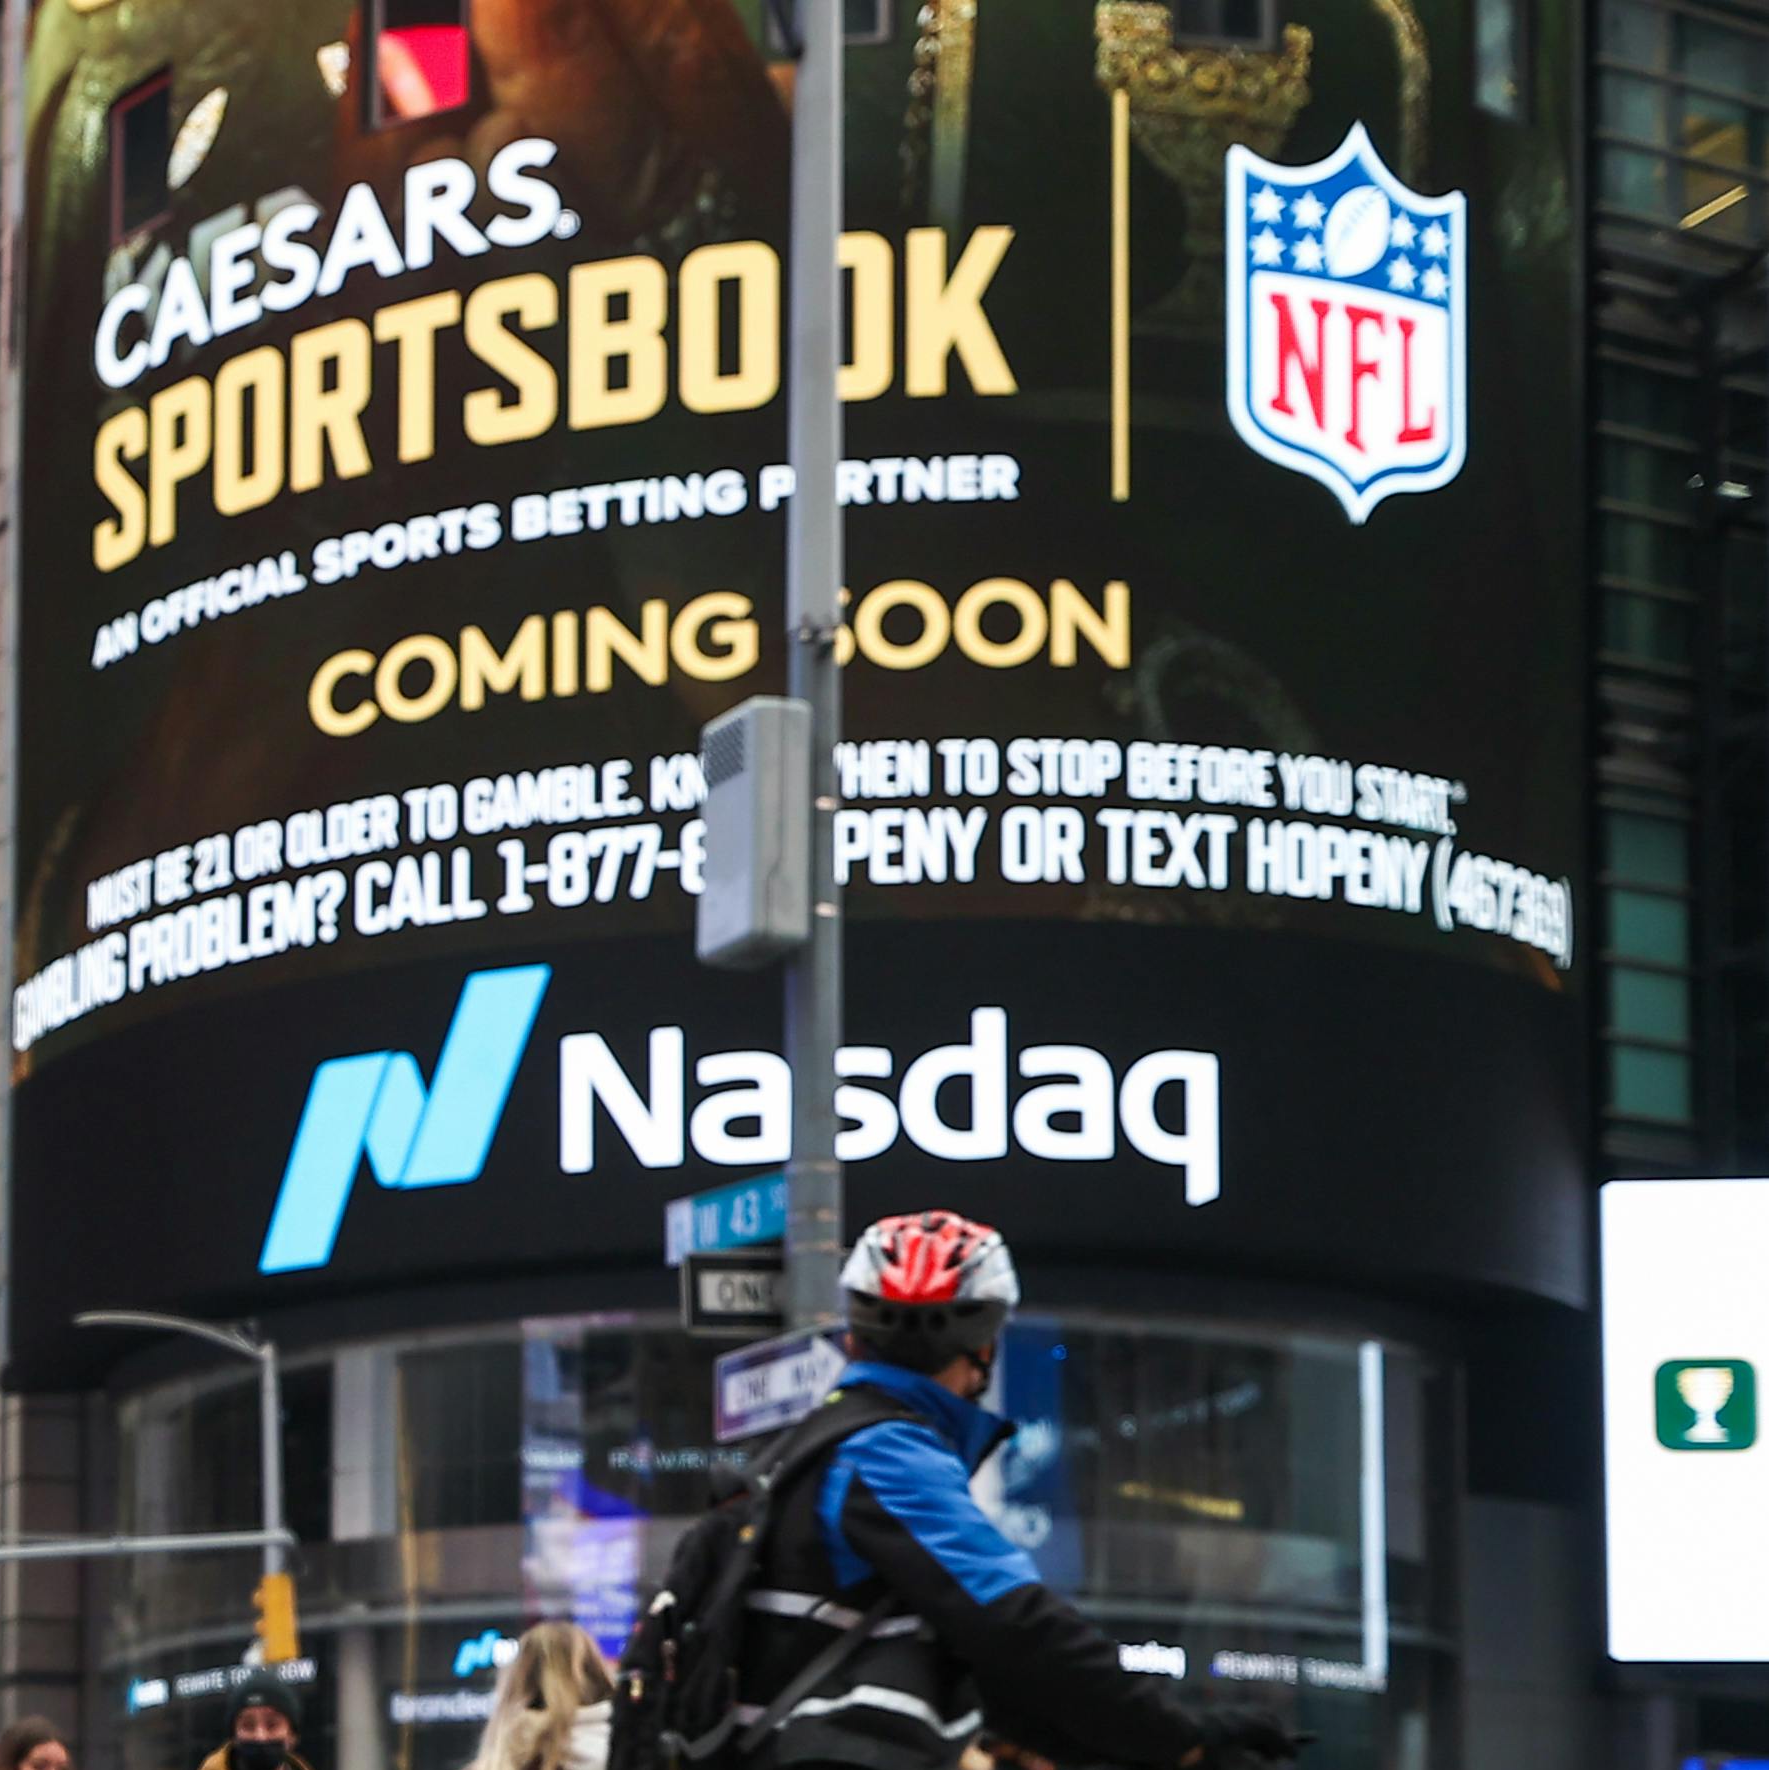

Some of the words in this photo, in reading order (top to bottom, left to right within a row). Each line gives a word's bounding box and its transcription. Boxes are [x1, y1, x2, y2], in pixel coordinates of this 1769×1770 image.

[1269, 293, 1436, 454] NFL
[92, 612, 139, 669] AN
[140, 551, 307, 646] OFFICIAL
[312, 503, 502, 584] SPORTS
[510, 469, 748, 541] BETTING
[759, 453, 1021, 511] PRTNER
[307, 591, 760, 738] COMING
[12, 930, 128, 1052] GAMBLING
[128, 869, 348, 993] PROBLEM?
[354, 846, 487, 936] CALL
[1000, 805, 1086, 884] OR
[1095, 808, 1239, 891] TEXT
[1246, 816, 1430, 914] HOPENY
[86, 857, 153, 931] MUST
[154, 846, 194, 904] BE
[193, 833, 234, 893] 21
[234, 819, 283, 881] OR
[286, 794, 400, 868] OLDER
[403, 784, 459, 843] TO
[463, 759, 643, 835] GAMBLE.
[833, 740, 930, 798] HEN
[936, 738, 1000, 796] TO
[1006, 737, 1123, 797] STOP
[1126, 741, 1277, 808] BEFORE
[1277, 752, 1353, 816] YOU
[559, 1006, 1220, 1206] Nasdaq
[730, 1186, 761, 1238] 43
